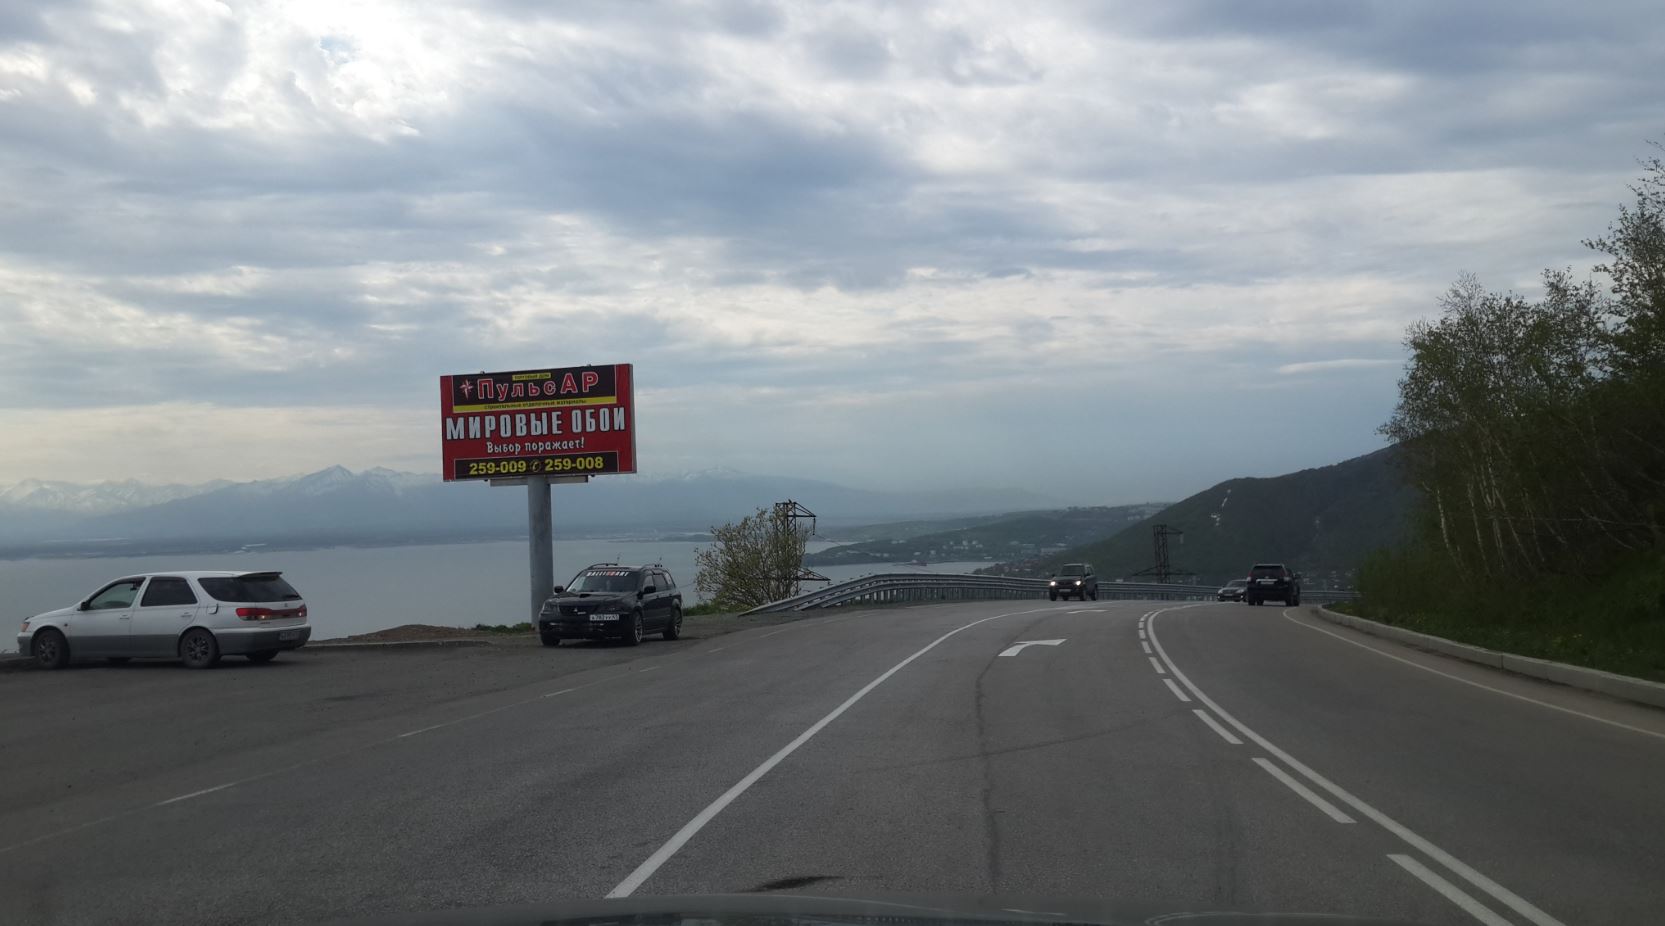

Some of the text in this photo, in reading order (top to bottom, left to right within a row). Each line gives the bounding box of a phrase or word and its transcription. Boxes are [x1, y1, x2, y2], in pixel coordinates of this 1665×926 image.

[477, 372, 599, 401] ПульсАР
[445, 407, 626, 440] МИРОВЫЕ ОБОИ
[486, 437, 585, 454] Выбор поражает!
[469, 456, 604, 475] 259-009 259-008
